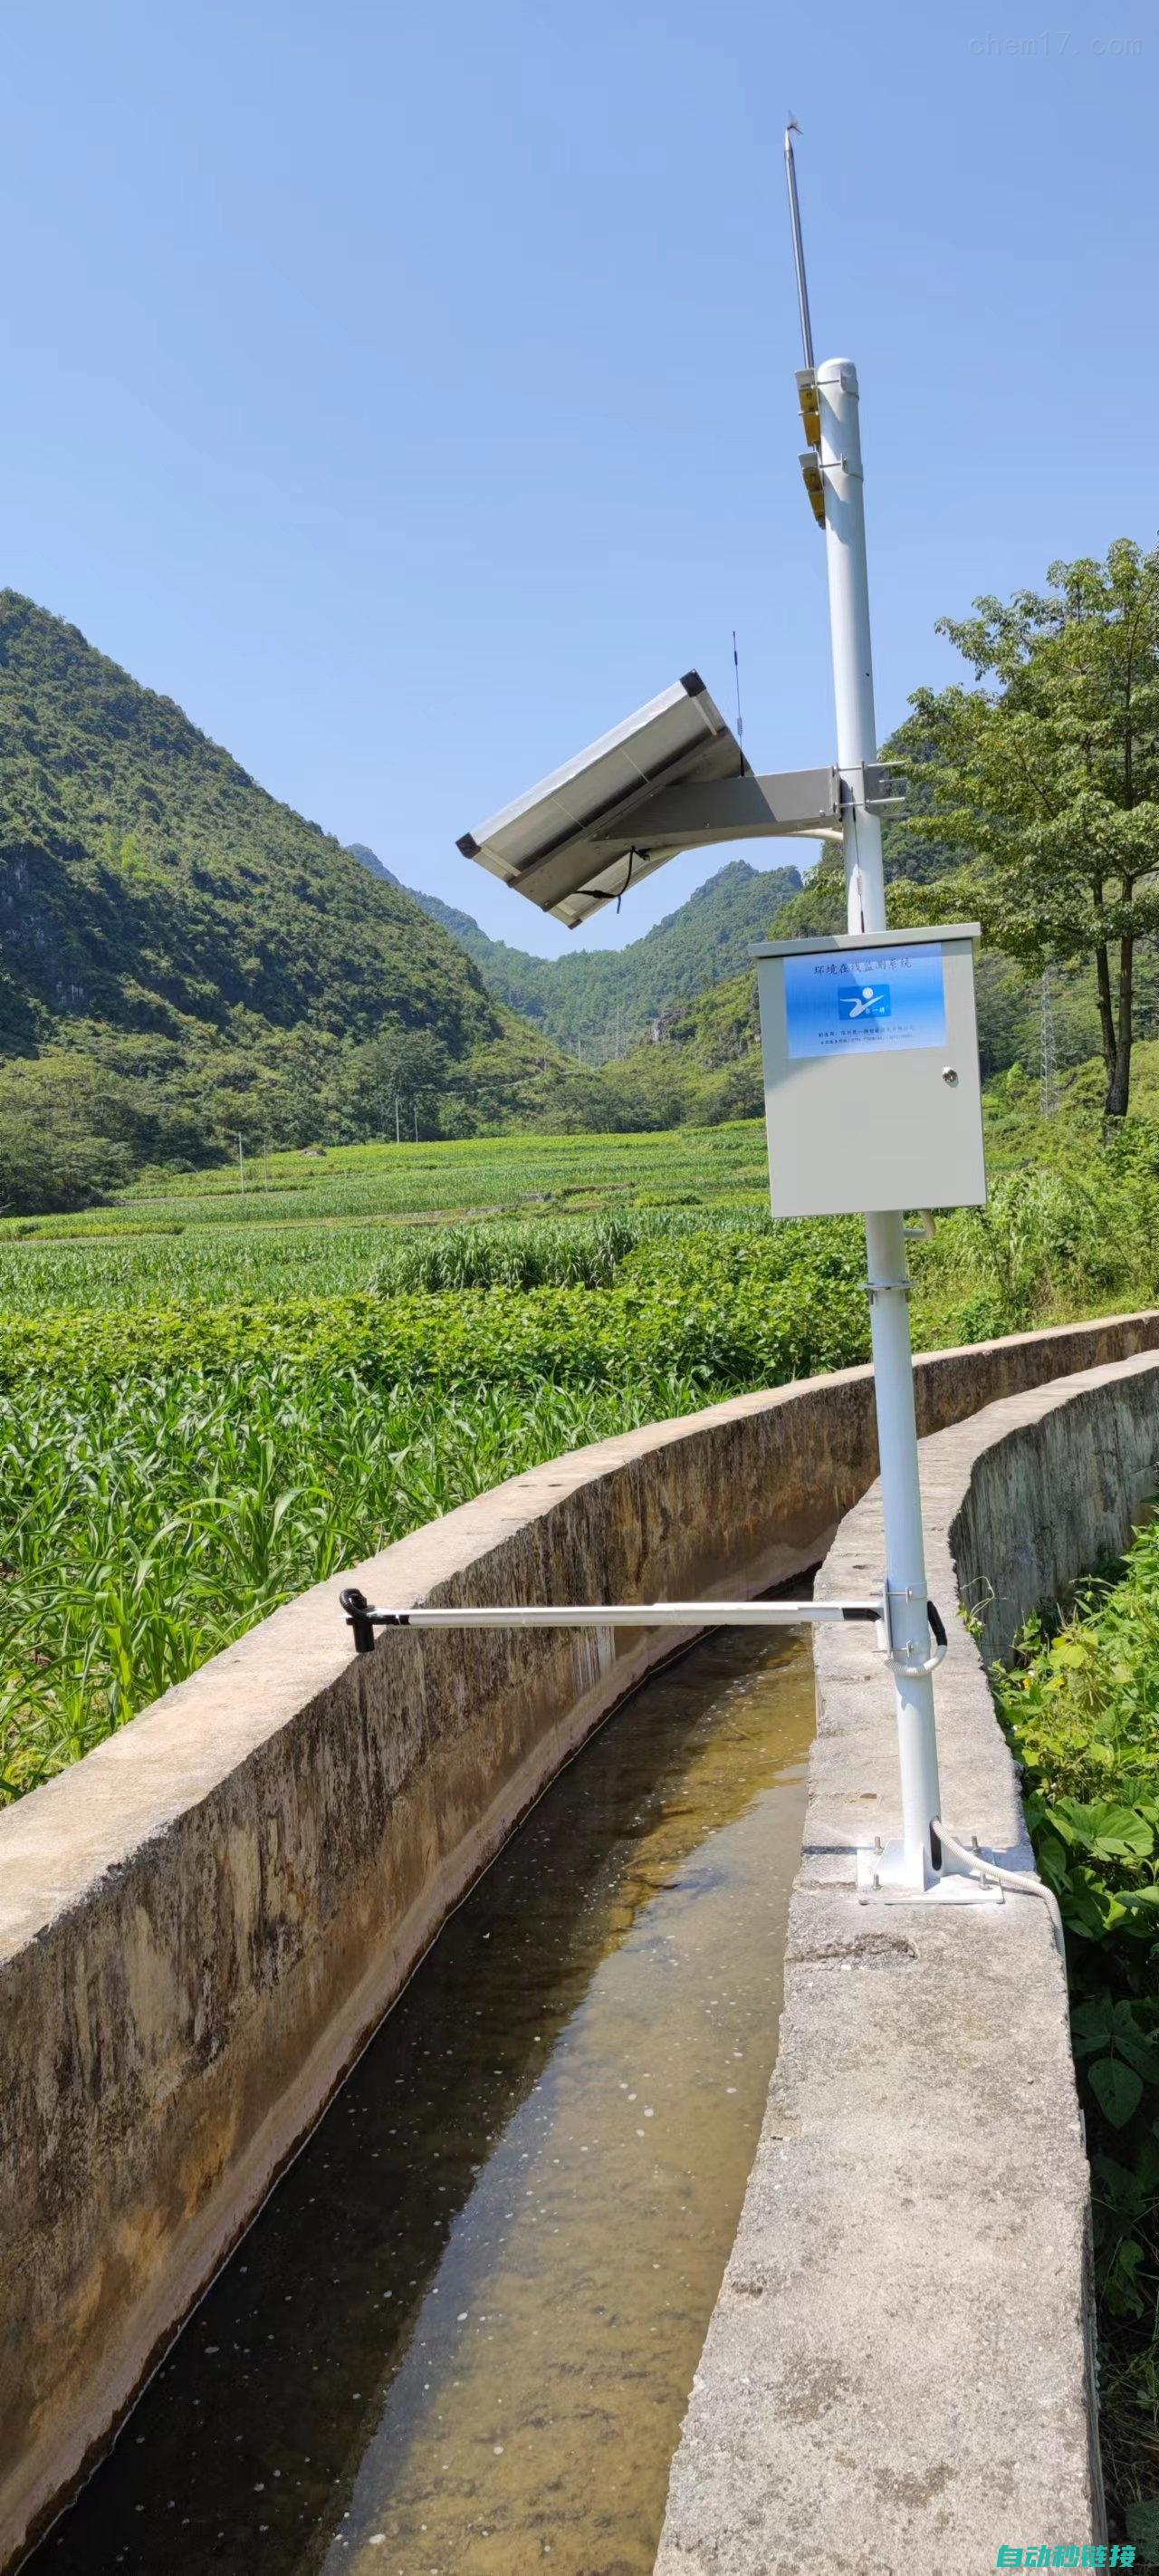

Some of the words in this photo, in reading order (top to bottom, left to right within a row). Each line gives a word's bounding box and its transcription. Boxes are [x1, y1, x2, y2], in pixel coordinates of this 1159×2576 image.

[814, 957, 913, 976] 环境在线监测系统
